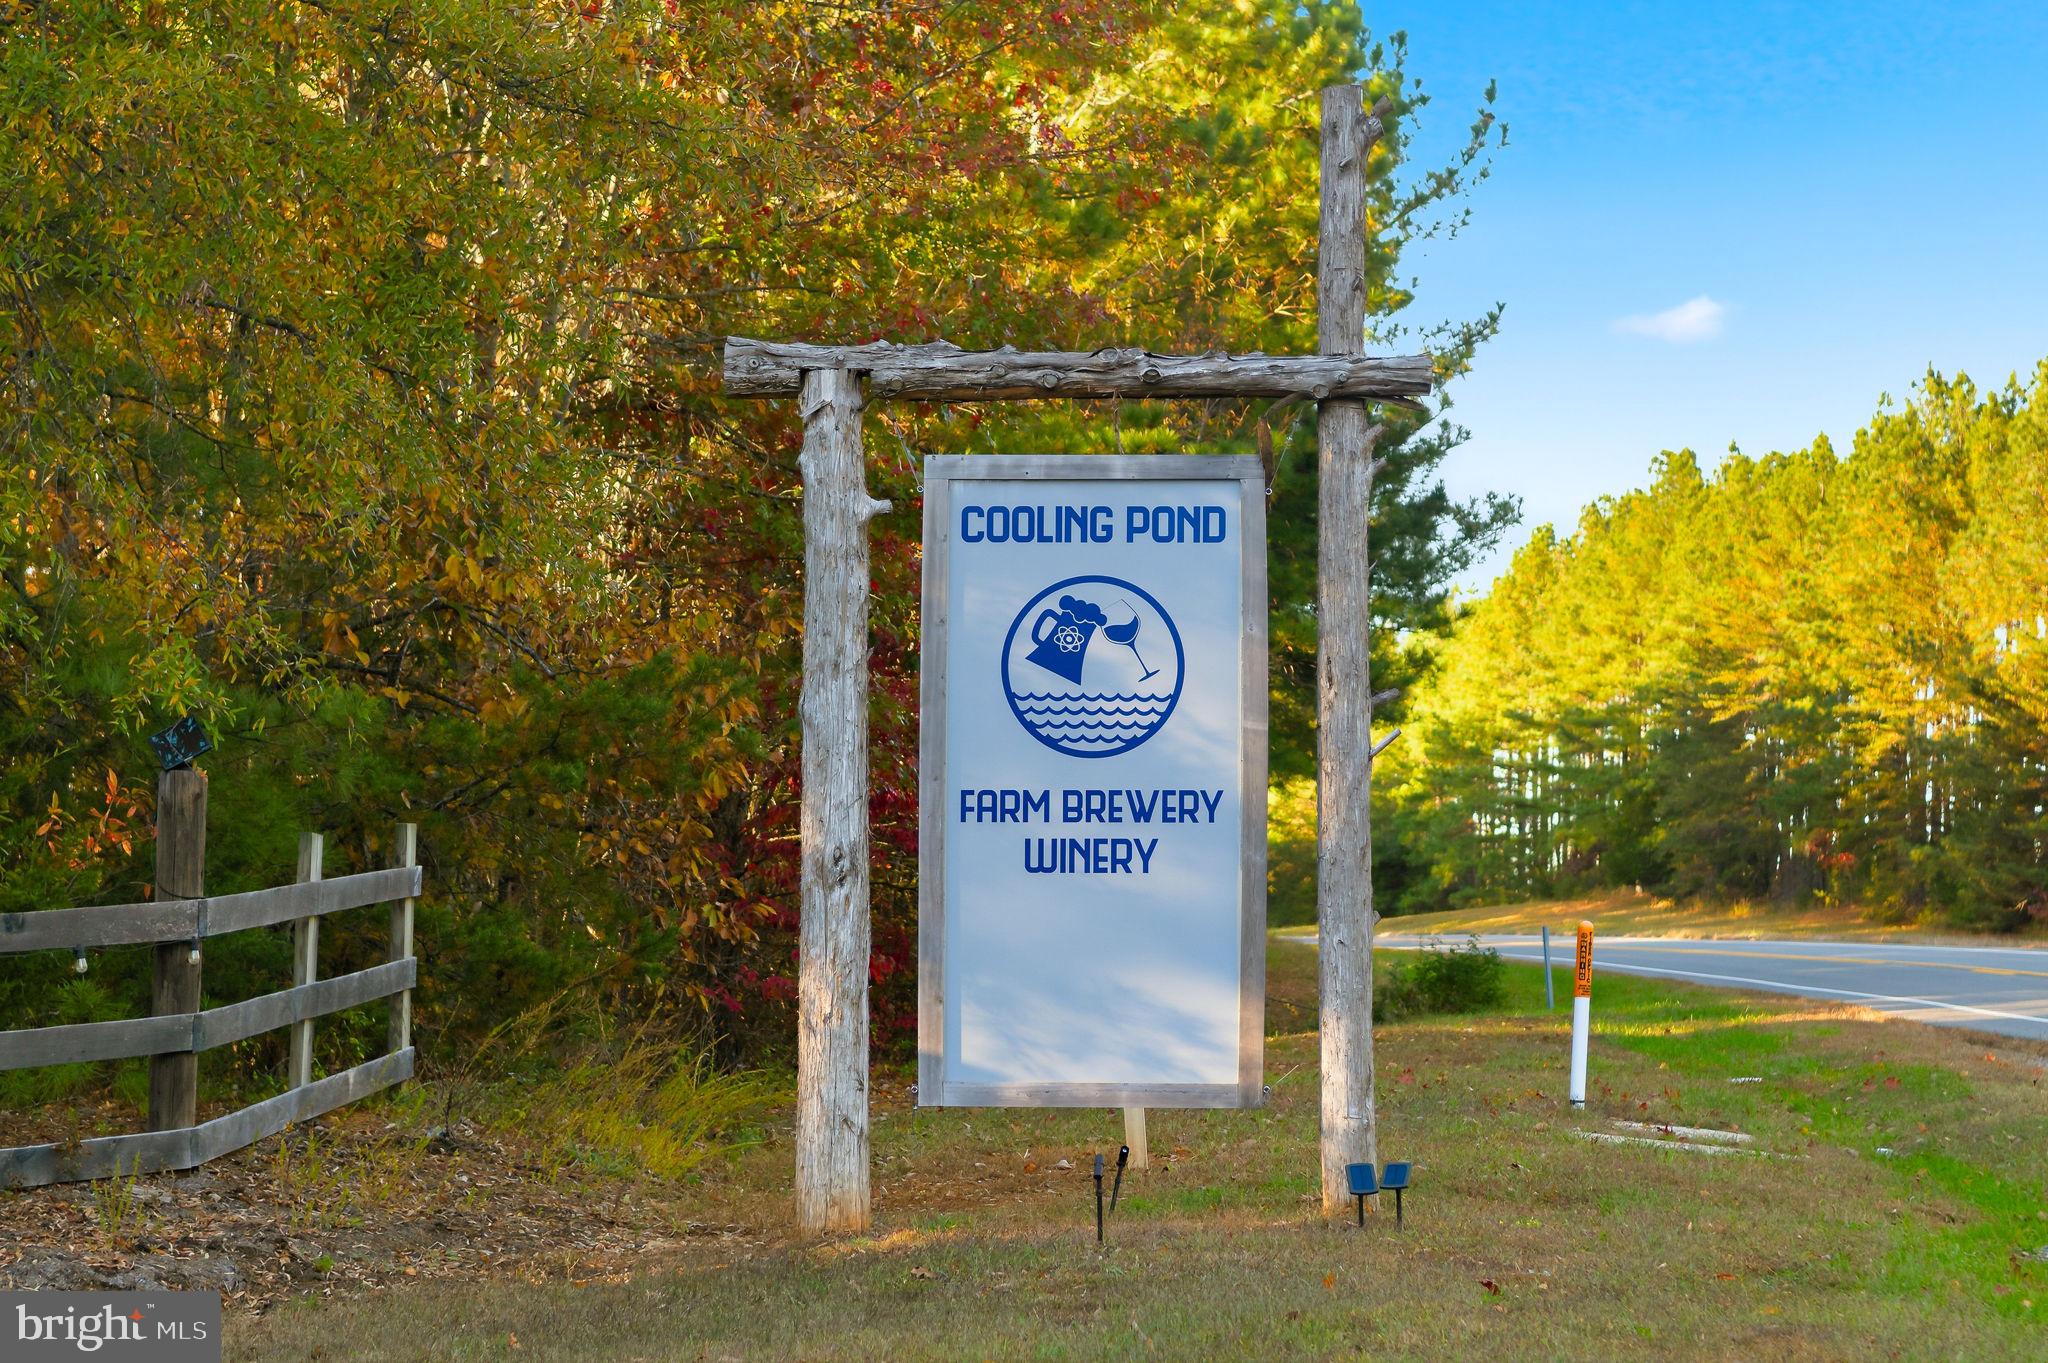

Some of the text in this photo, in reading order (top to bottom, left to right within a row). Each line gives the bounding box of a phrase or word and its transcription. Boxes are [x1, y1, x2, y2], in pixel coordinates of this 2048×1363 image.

[961, 505, 1227, 544] COOLING POND
[960, 790, 1224, 823] FARM BREWERY
[1024, 838, 1159, 874] WINERY
